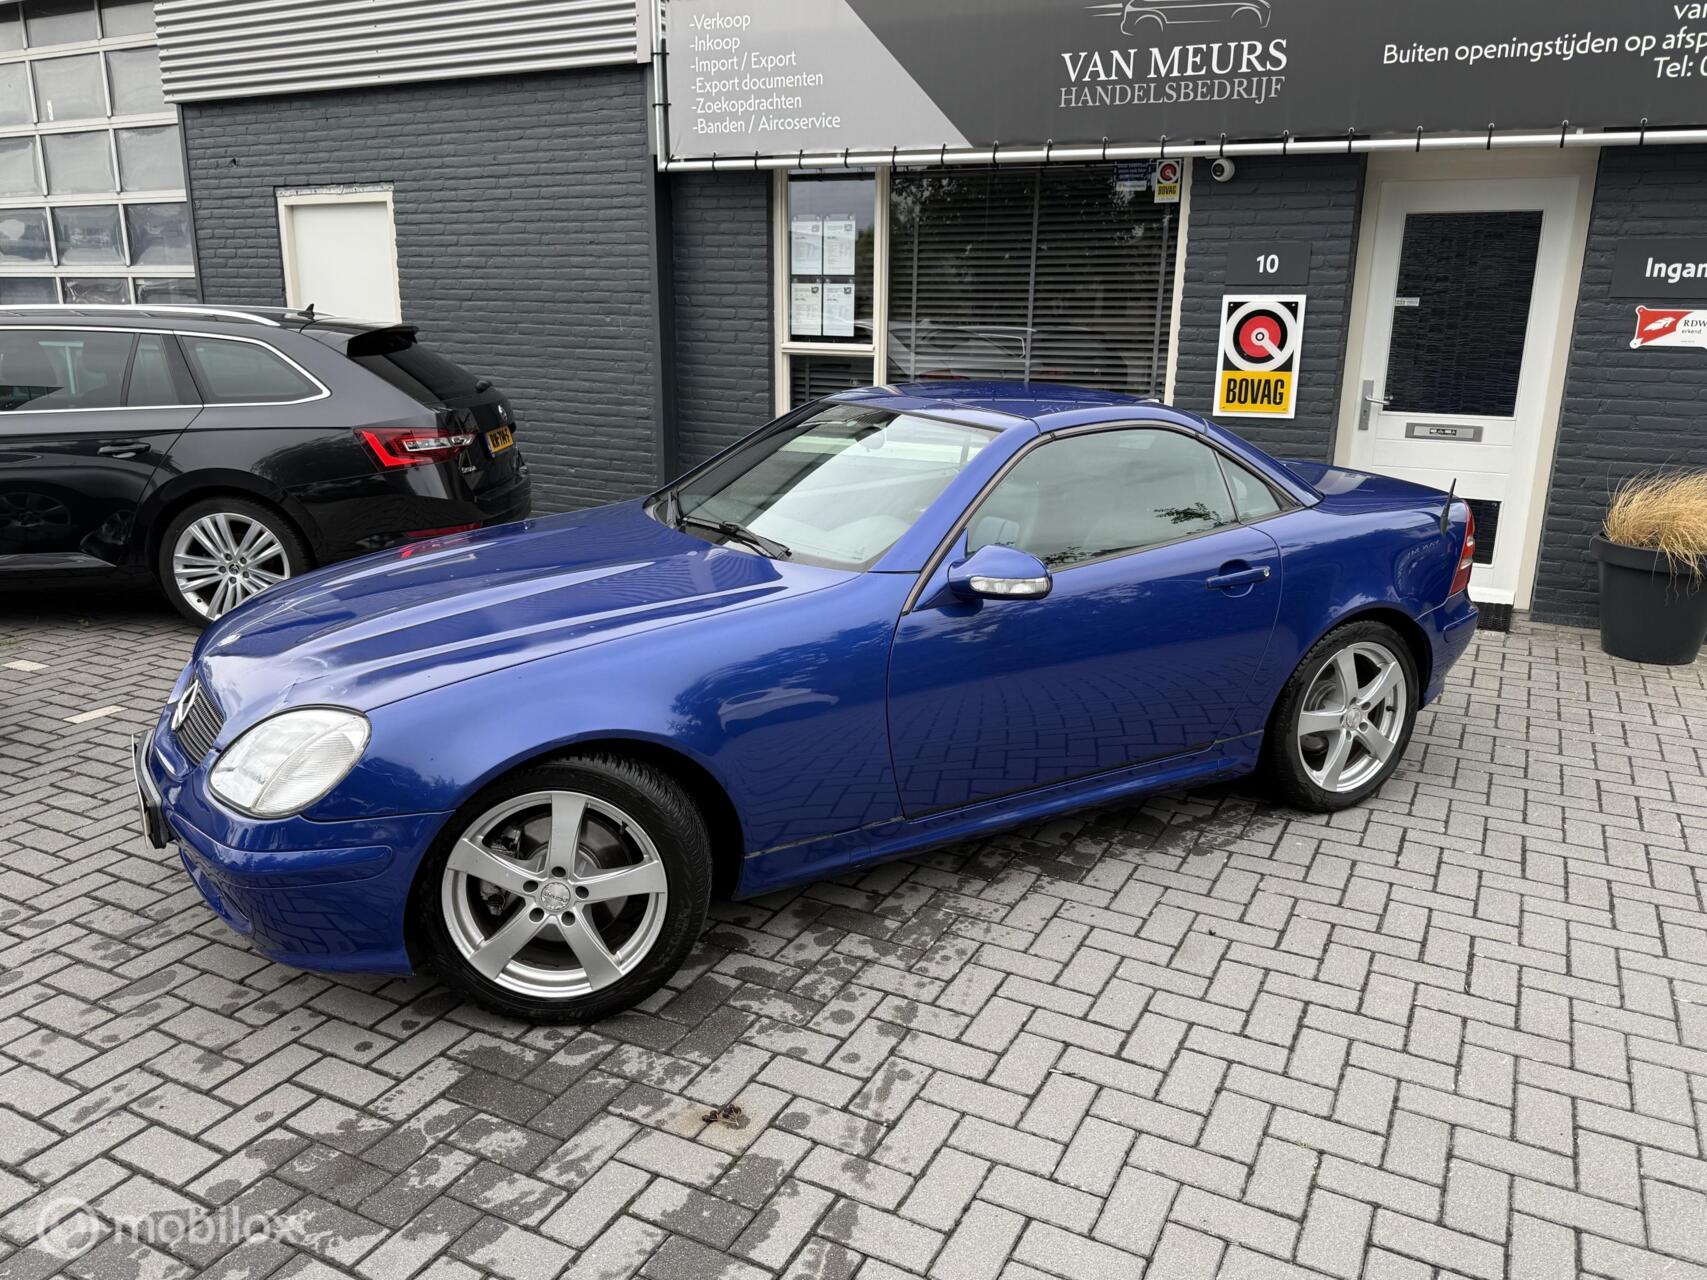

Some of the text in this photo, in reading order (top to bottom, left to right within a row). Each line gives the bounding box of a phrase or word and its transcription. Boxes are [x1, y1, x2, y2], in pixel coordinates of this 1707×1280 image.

[689, 13, 751, 31] -Verkoop
[689, 35, 741, 52] -Inkoop
[1383, 42, 1449, 64] Buiten
[1455, 31, 1618, 65] openingstijden
[1625, 34, 1656, 57] op
[690, 50, 797, 75] -Import / Export
[1061, 38, 1288, 83] VAN MEURS
[1653, 54, 1694, 78] Tel:
[691, 72, 824, 95] -Export documenten
[1058, 75, 1286, 108] HANDELSBEDRIJF
[691, 94, 802, 115] -Zoekopdrachten
[692, 112, 841, 135] -Banden / Aircoservice
[1256, 254, 1279, 274] 10
[1645, 256, 1707, 284] Ingan
[1225, 377, 1285, 405] BOVAG
